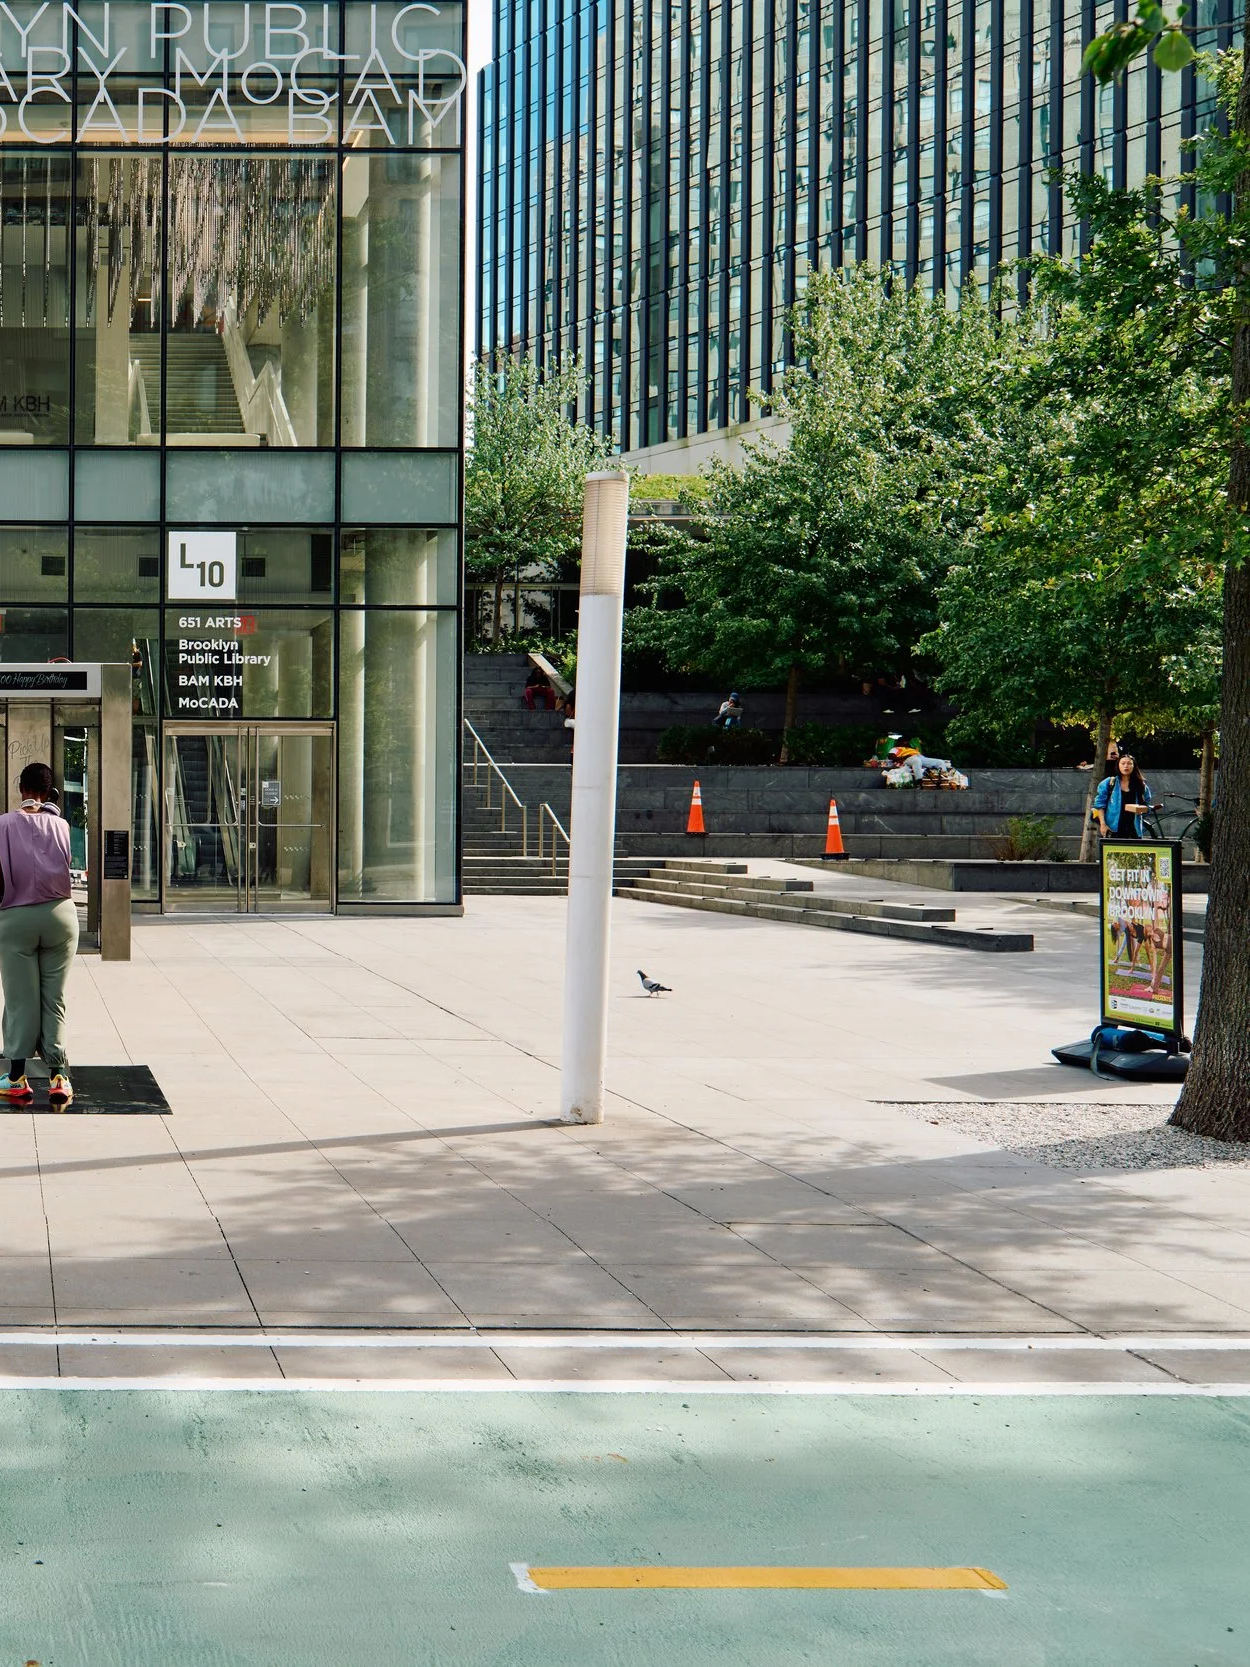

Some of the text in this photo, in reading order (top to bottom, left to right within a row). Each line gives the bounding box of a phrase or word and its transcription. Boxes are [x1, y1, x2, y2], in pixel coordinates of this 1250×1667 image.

[151, 3, 441, 60] PUBLIC
[175, 47, 467, 105] MoCAD
[288, 88, 461, 145] BAM
[14, 395, 50, 412] KBH
[178, 616, 201, 628] 651
[204, 616, 242, 628] ARTS
[178, 638, 239, 652] Brooklyn
[178, 652, 271, 667] Public Library
[11, 672, 36, 688] Happy
[36, 673, 69, 689] Birthday
[178, 675, 243, 686] BAM KBH
[178, 697, 239, 709] MoCADA
[1109, 868, 1151, 883] GET FIT IN
[1109, 886, 1163, 902] DOWNTOWN
[1109, 903, 1156, 920] BROOKLYN
